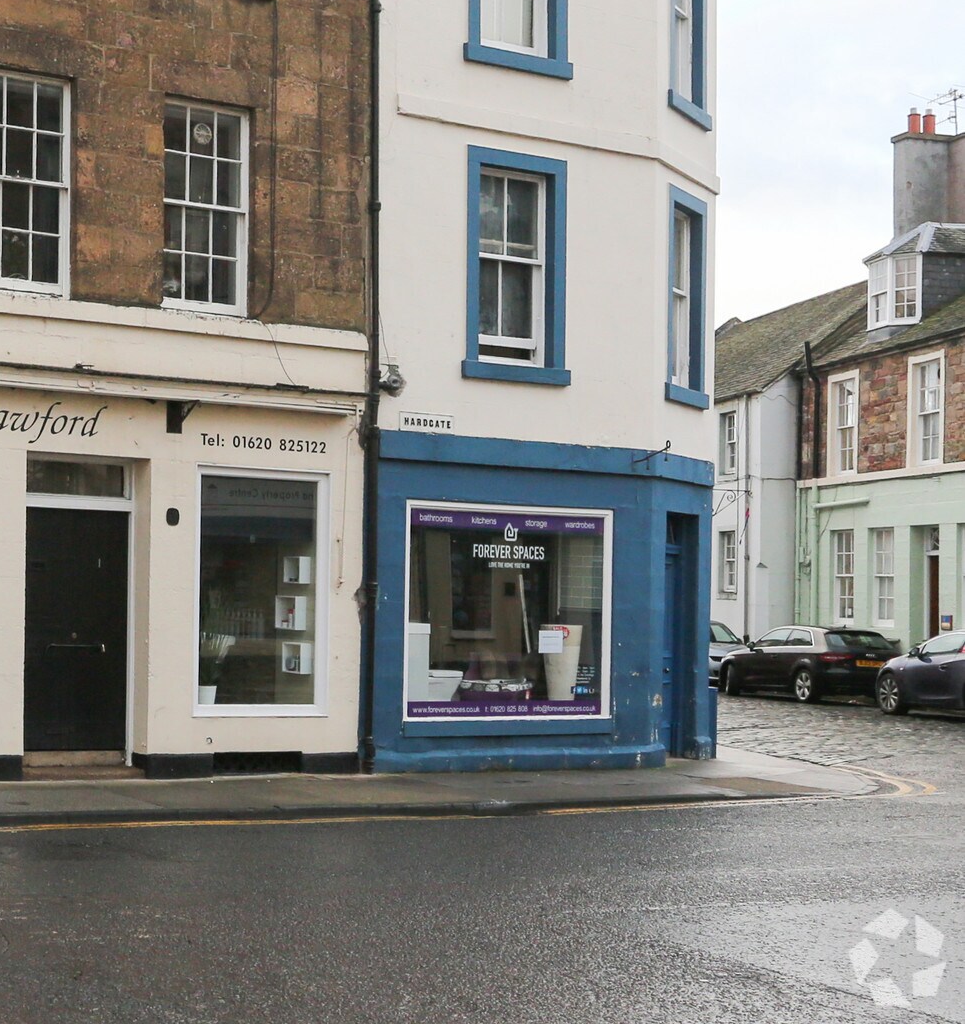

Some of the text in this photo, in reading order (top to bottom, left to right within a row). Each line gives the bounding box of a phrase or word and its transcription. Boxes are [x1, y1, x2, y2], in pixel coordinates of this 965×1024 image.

[404, 417, 451, 429] HARDGATE
[200, 433, 326, 454] Tel: 01620 825122
[419, 514, 453, 523] bathrooms
[472, 516, 497, 525] kitchens
[525, 520, 547, 528] storage
[472, 544, 545, 560] FOREVER SPACES
[412, 706, 480, 714] www.foreverspaces.co.uk
[533, 705, 596, 714] info@foreverspaces.co.uk
